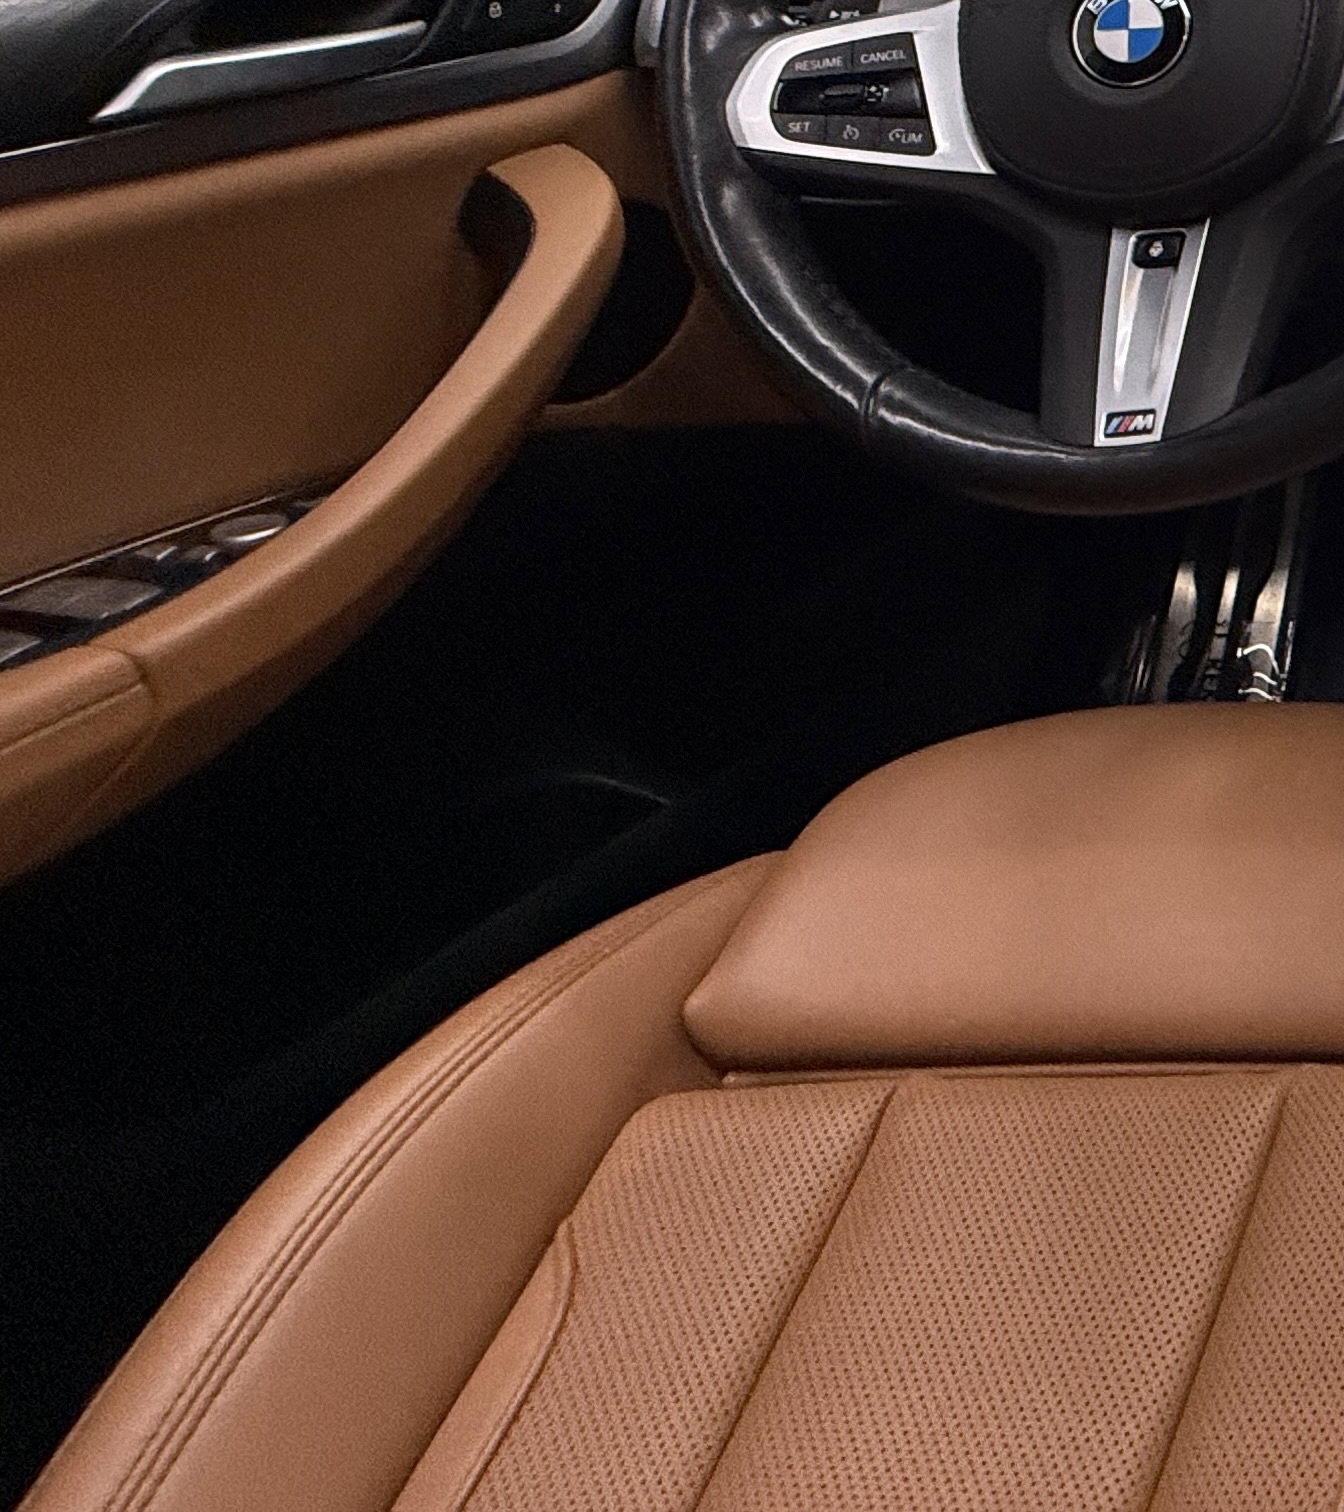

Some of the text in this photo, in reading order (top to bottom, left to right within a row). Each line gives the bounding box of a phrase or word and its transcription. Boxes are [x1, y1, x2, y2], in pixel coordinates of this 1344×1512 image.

[795, 55, 843, 72] RESUME
[860, 49, 907, 65] CANCEL
[788, 121, 811, 134] SET
